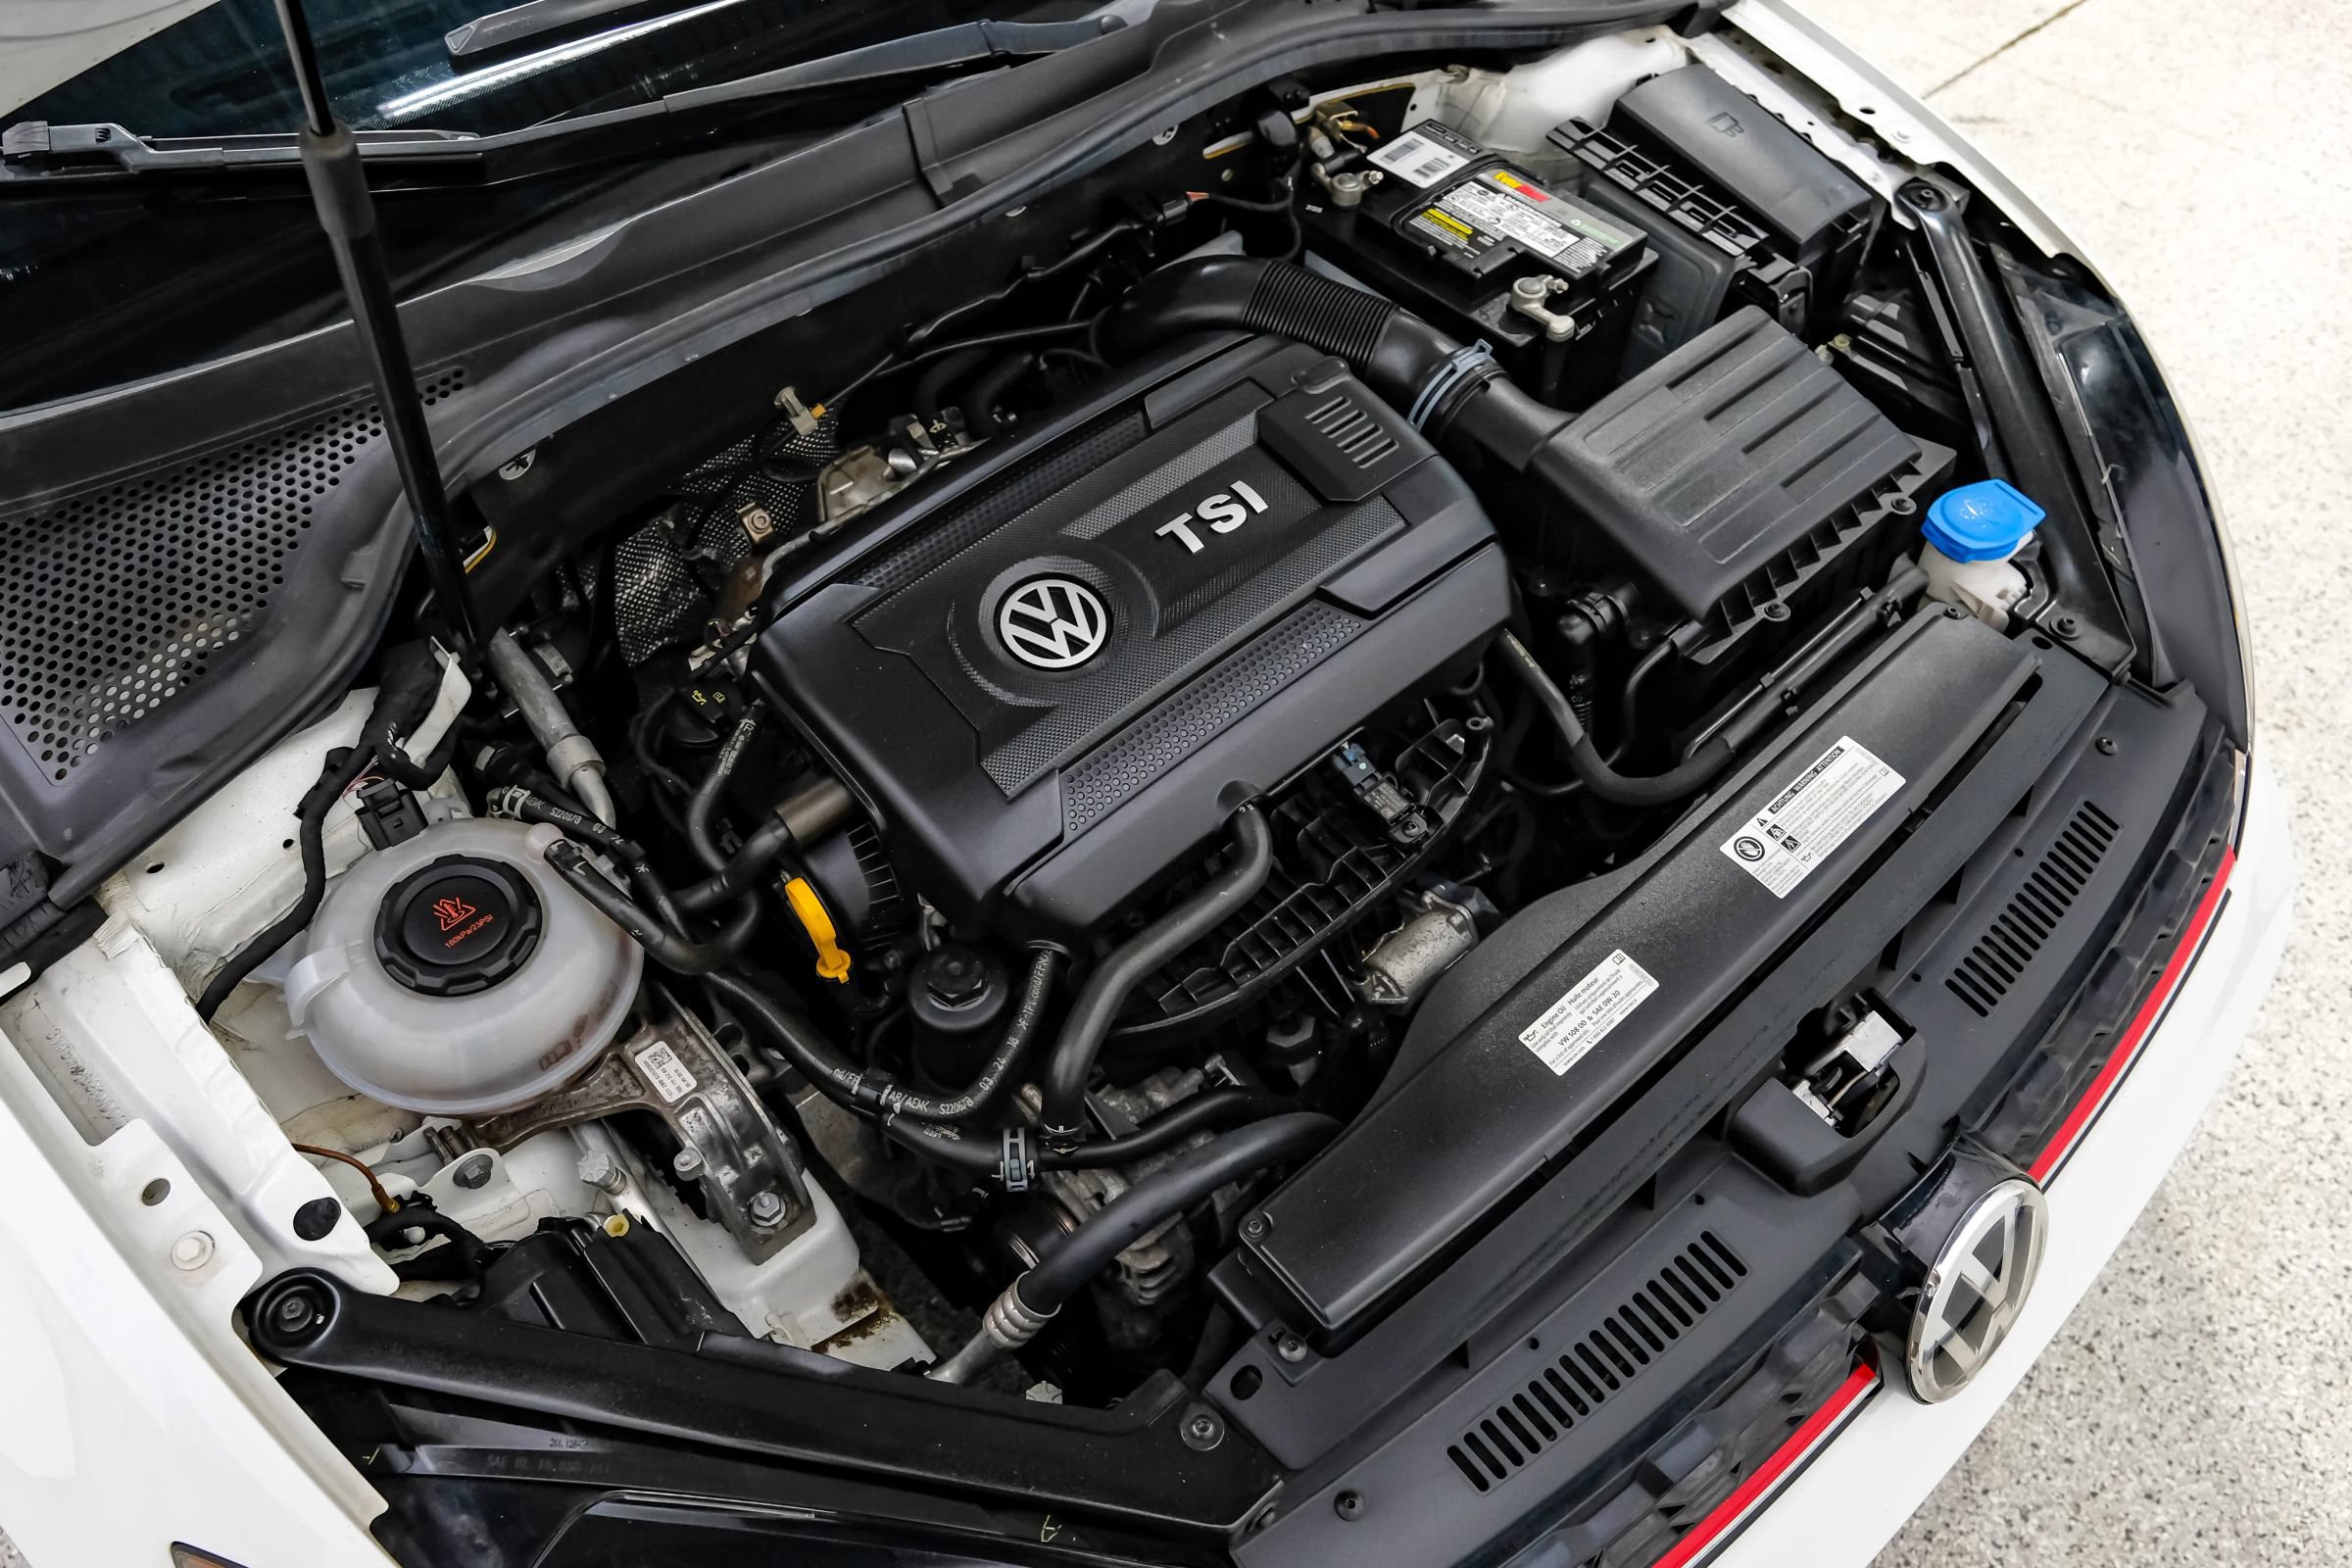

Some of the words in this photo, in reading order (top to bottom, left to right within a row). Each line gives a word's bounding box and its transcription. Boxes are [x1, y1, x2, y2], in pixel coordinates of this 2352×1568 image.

[1154, 480, 1268, 556] TSI
[1770, 791, 1794, 812] ACHTUNG
[1793, 770, 1818, 791] WARNING
[1816, 749, 1841, 771] ATTENTION
[1541, 1012, 1561, 1030] Engine
[1556, 1005, 1566, 1014] Oil
[1567, 992, 1582, 1005] Huile
[1580, 977, 1599, 994] moteur
[1558, 1035, 1570, 1047] VW
[1567, 1026, 1580, 1038] 508
[1577, 1019, 1588, 1029] 00
[1592, 1004, 1604, 1015] SAE
[1601, 990, 1621, 1007] 0W-20
[1535, 1038, 1551, 1054] complies
[1549, 1031, 1559, 1040] with
[978, 1076, 994, 1091] 03
